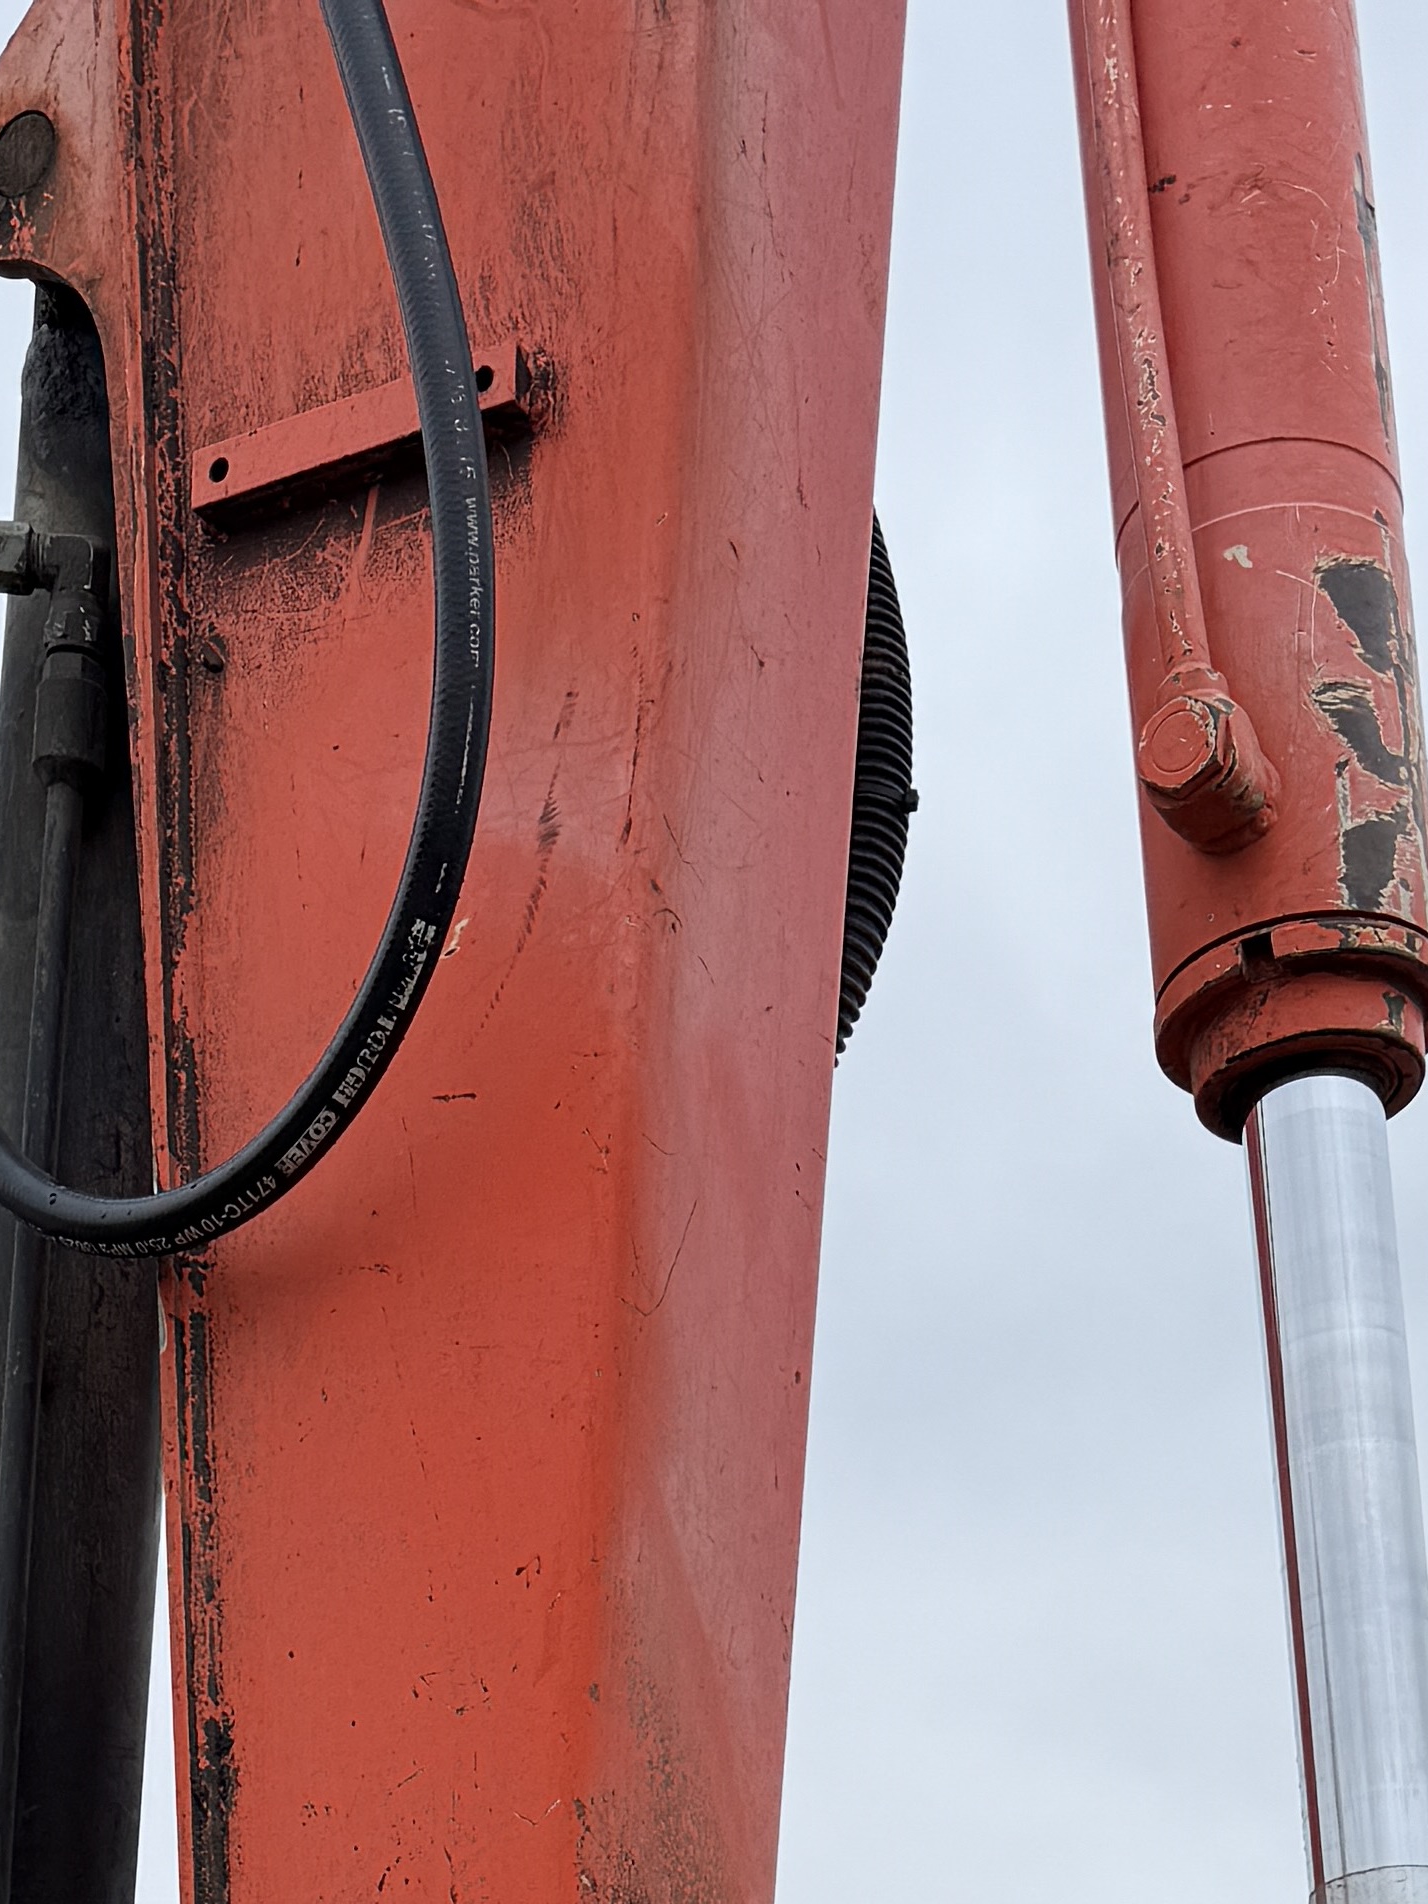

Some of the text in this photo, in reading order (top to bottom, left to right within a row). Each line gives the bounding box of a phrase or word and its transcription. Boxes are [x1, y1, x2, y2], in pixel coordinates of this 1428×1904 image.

[274, 1105, 340, 1177] COVER
[200, 1173, 278, 1234] 471TC-10
[174, 1227, 200, 1247] WP
